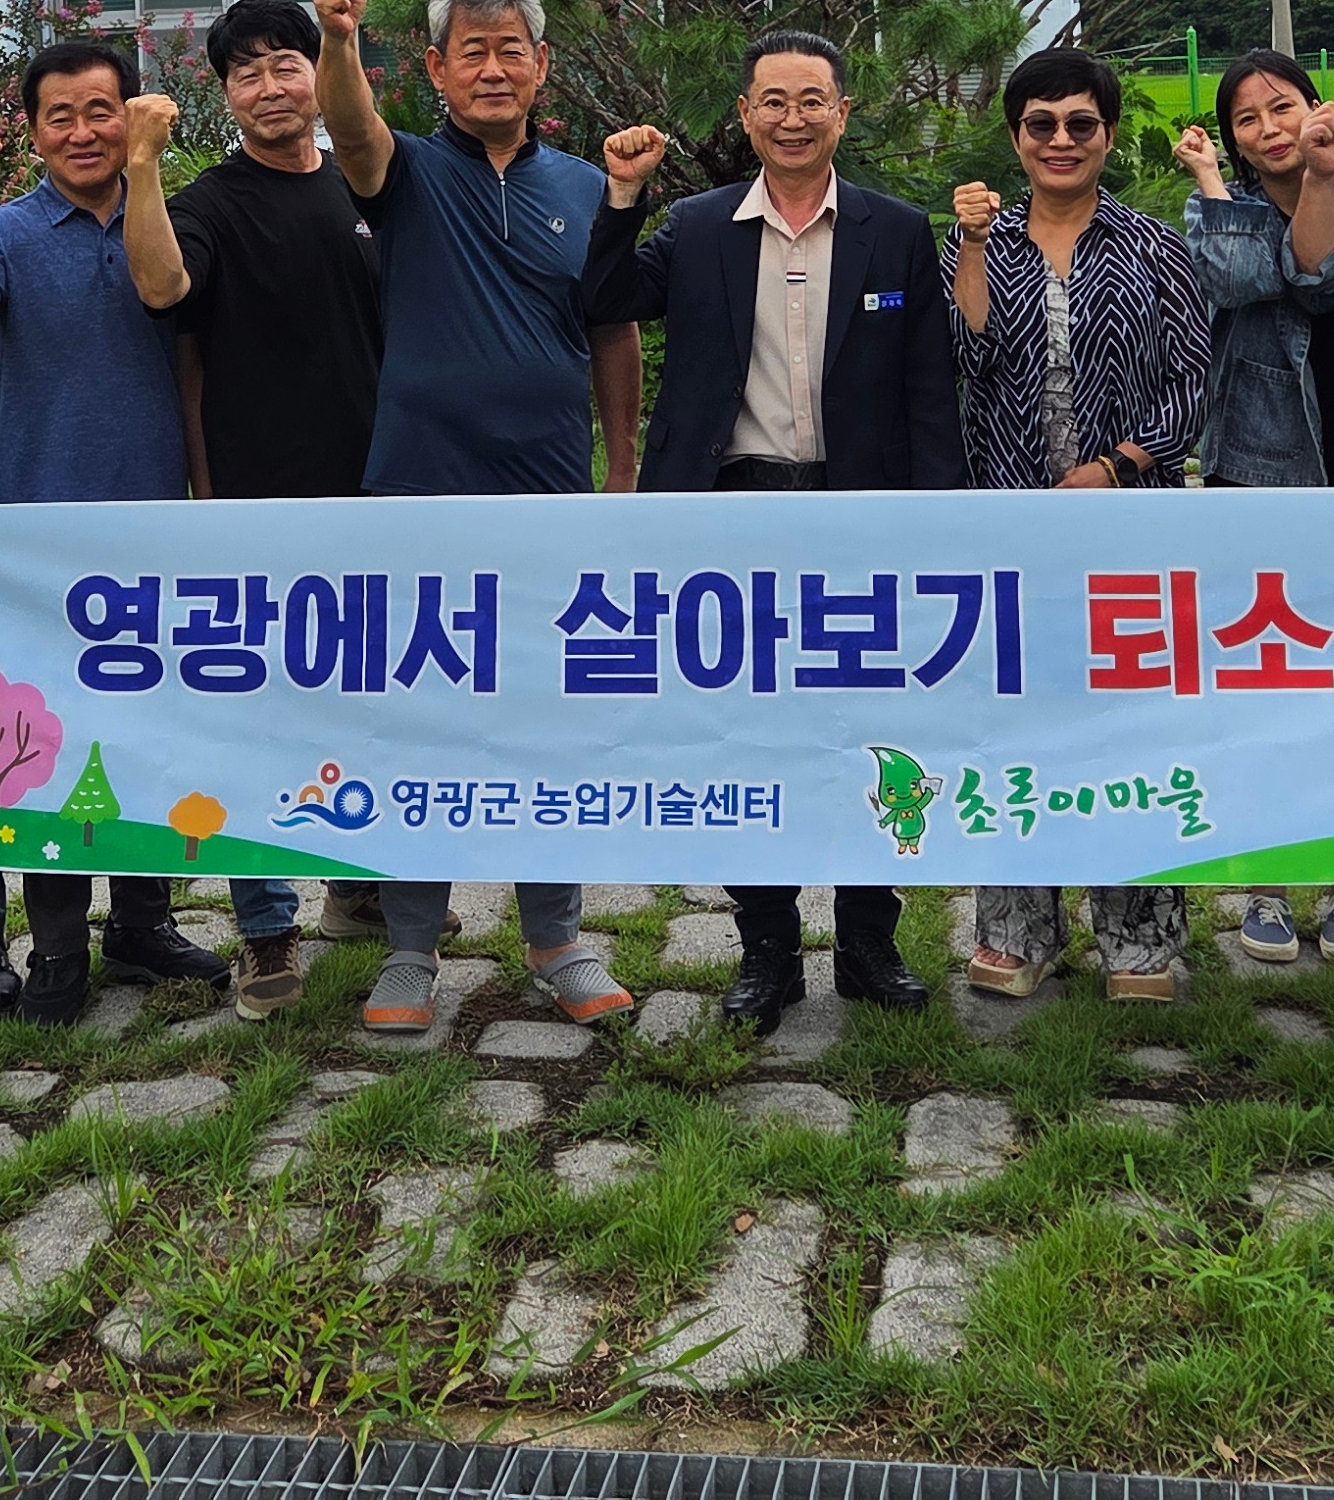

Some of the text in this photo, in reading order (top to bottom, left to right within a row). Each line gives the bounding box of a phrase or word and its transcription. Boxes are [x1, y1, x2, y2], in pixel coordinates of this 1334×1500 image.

[65, 572, 500, 696] 영광에서
[554, 570, 1021, 696] 살아보기
[391, 779, 781, 829] 영광군 농업기술센터
